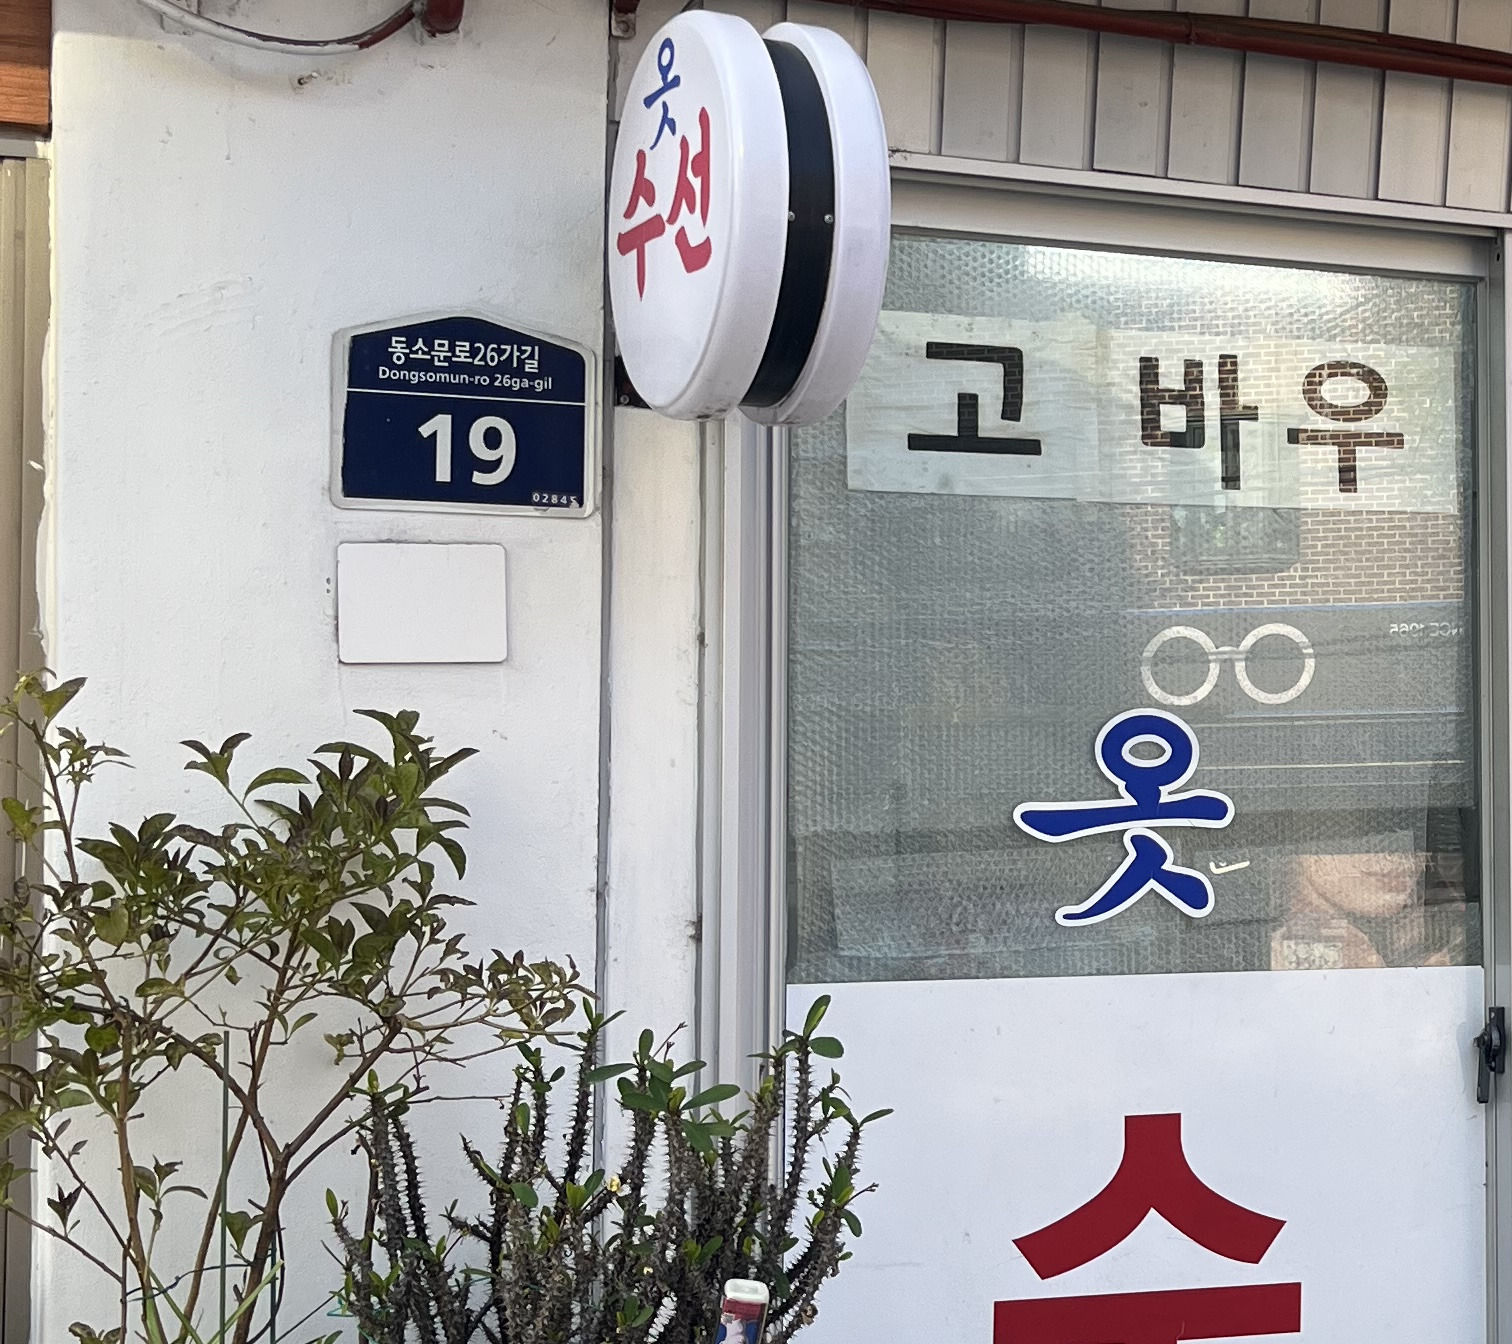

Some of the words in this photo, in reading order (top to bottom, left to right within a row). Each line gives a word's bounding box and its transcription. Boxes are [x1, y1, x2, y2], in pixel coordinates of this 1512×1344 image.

[643, 37, 680, 150] 옷
[617, 107, 713, 301] 수선
[378, 366, 490, 386] Dongsomun-ro
[493, 374, 553, 392] 26ga-gil
[387, 336, 540, 373] 동소문로26가길
[418, 413, 517, 486] 19
[532, 492, 578, 506] 02845
[1016, 711, 1233, 924] 옷
